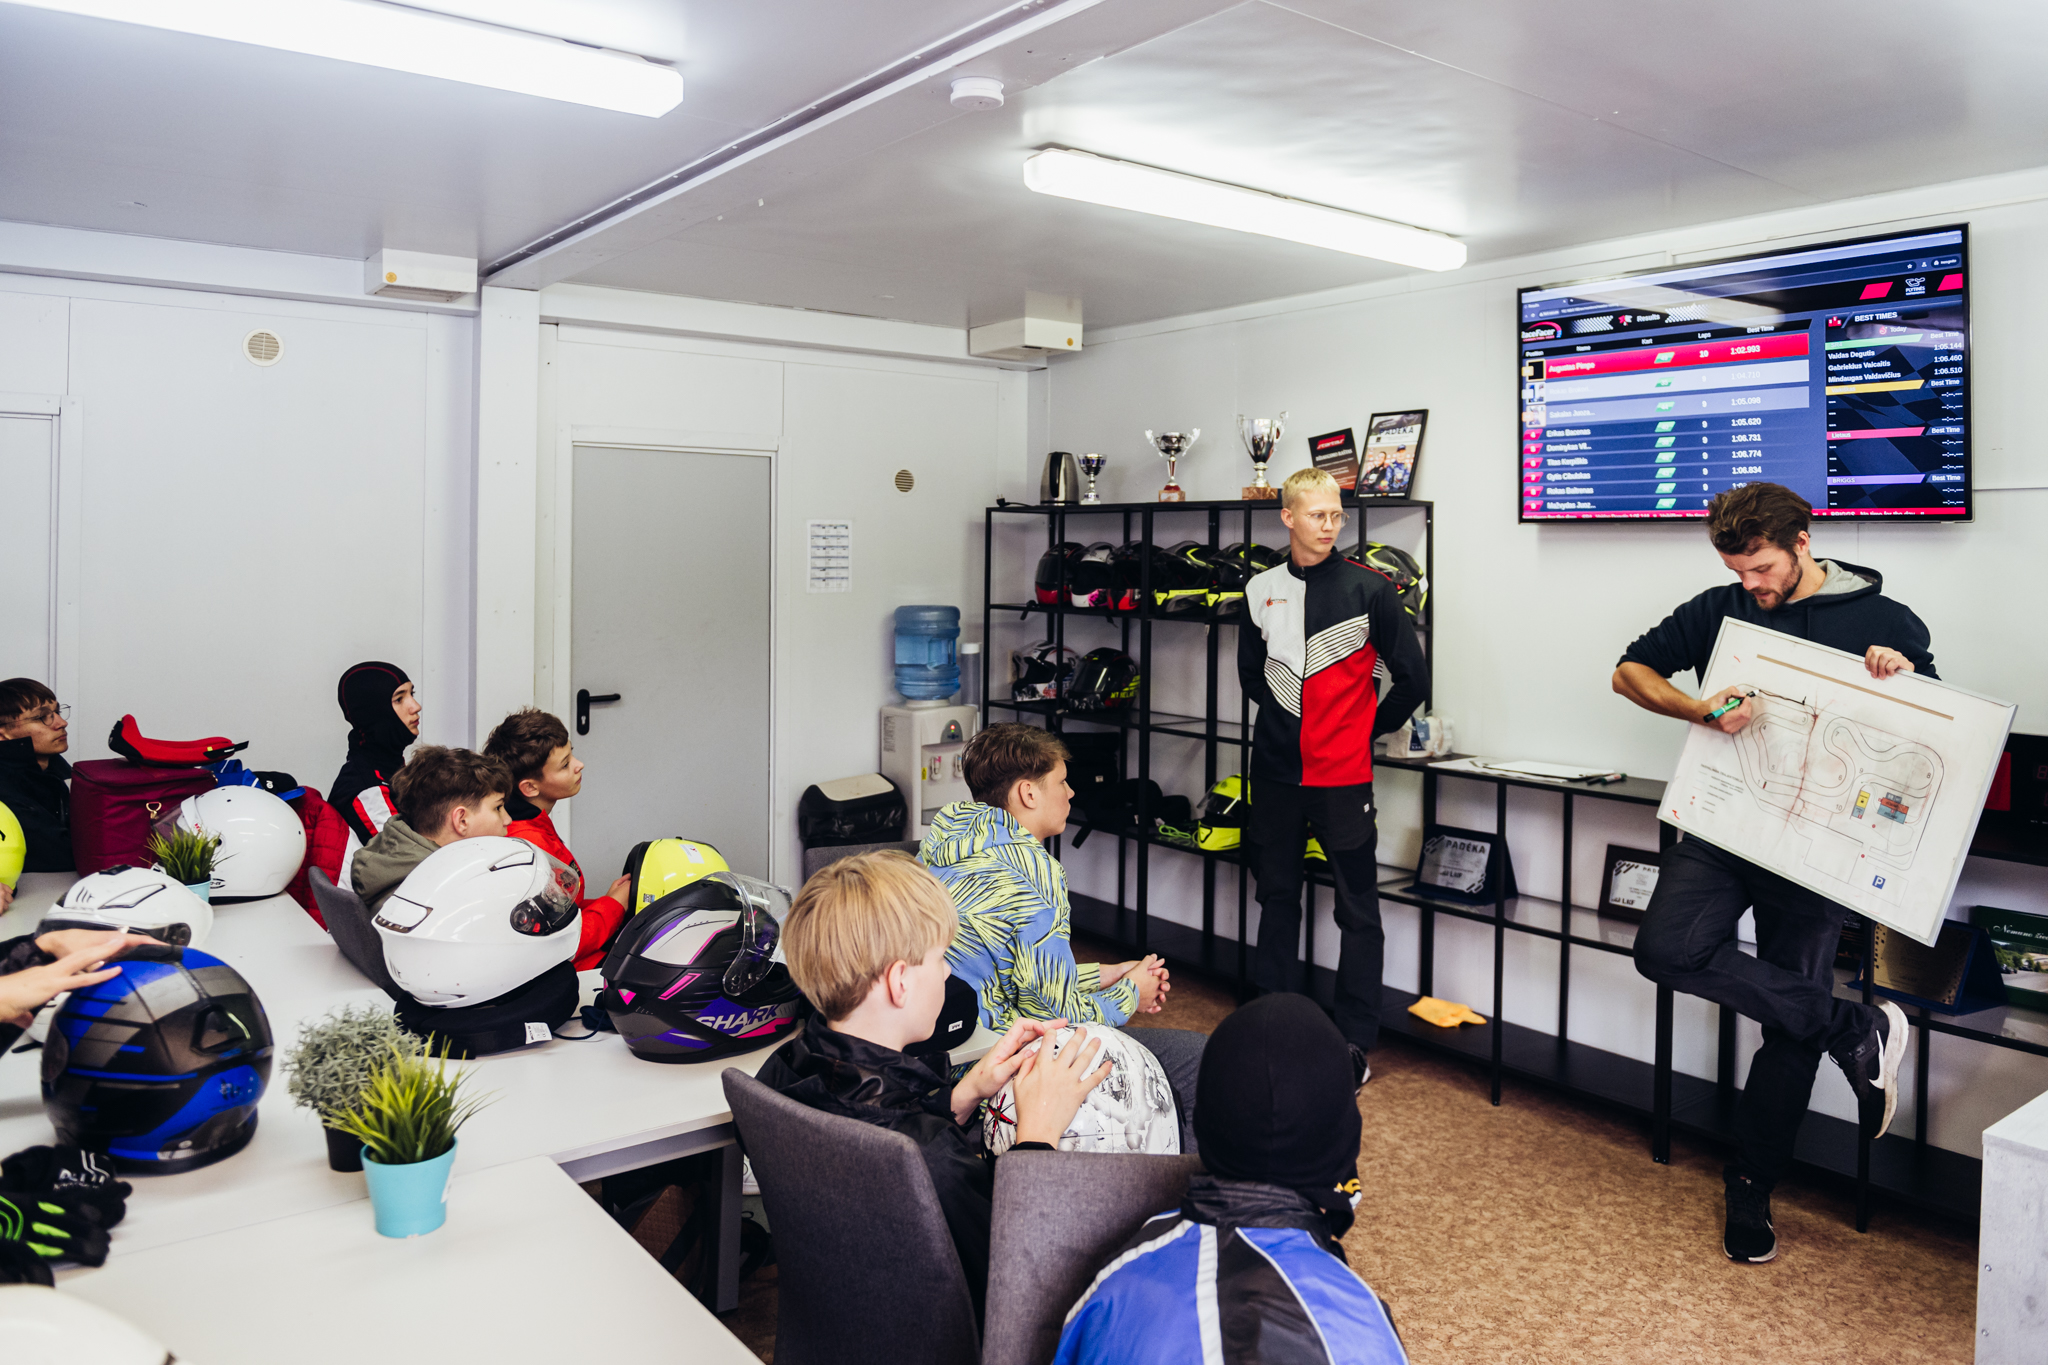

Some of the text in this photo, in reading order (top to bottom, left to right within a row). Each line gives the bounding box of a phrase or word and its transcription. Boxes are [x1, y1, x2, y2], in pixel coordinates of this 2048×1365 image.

[1637, 314, 1660, 322] Results
[1854, 312, 1898, 322] BEST TIMES
[1730, 345, 1761, 355] 1:02.993
[1934, 342, 1962, 351] 1:05.144
[1699, 350, 1709, 358] 10
[1850, 350, 1875, 359] Degutis
[1934, 366, 1963, 375] 1:06.510
[1731, 371, 1761, 380] 1:04.710
[1828, 374, 1863, 383] Mindaugas
[1702, 400, 1707, 408] 9
[1702, 420, 1708, 429] 9
[1546, 430, 1564, 438] Erikas
[1702, 436, 1708, 444] 9
[1546, 443, 1578, 452] Dominykas
[1702, 451, 1708, 460] 9
[1546, 458, 1561, 466] Titas
[1702, 467, 1708, 476] 9
[1702, 483, 1709, 492] 9
[1445, 840, 1486, 854] PADĖKA
[1993, 924, 2033, 938] Nemuno
[695, 1004, 780, 1030] SHARK
